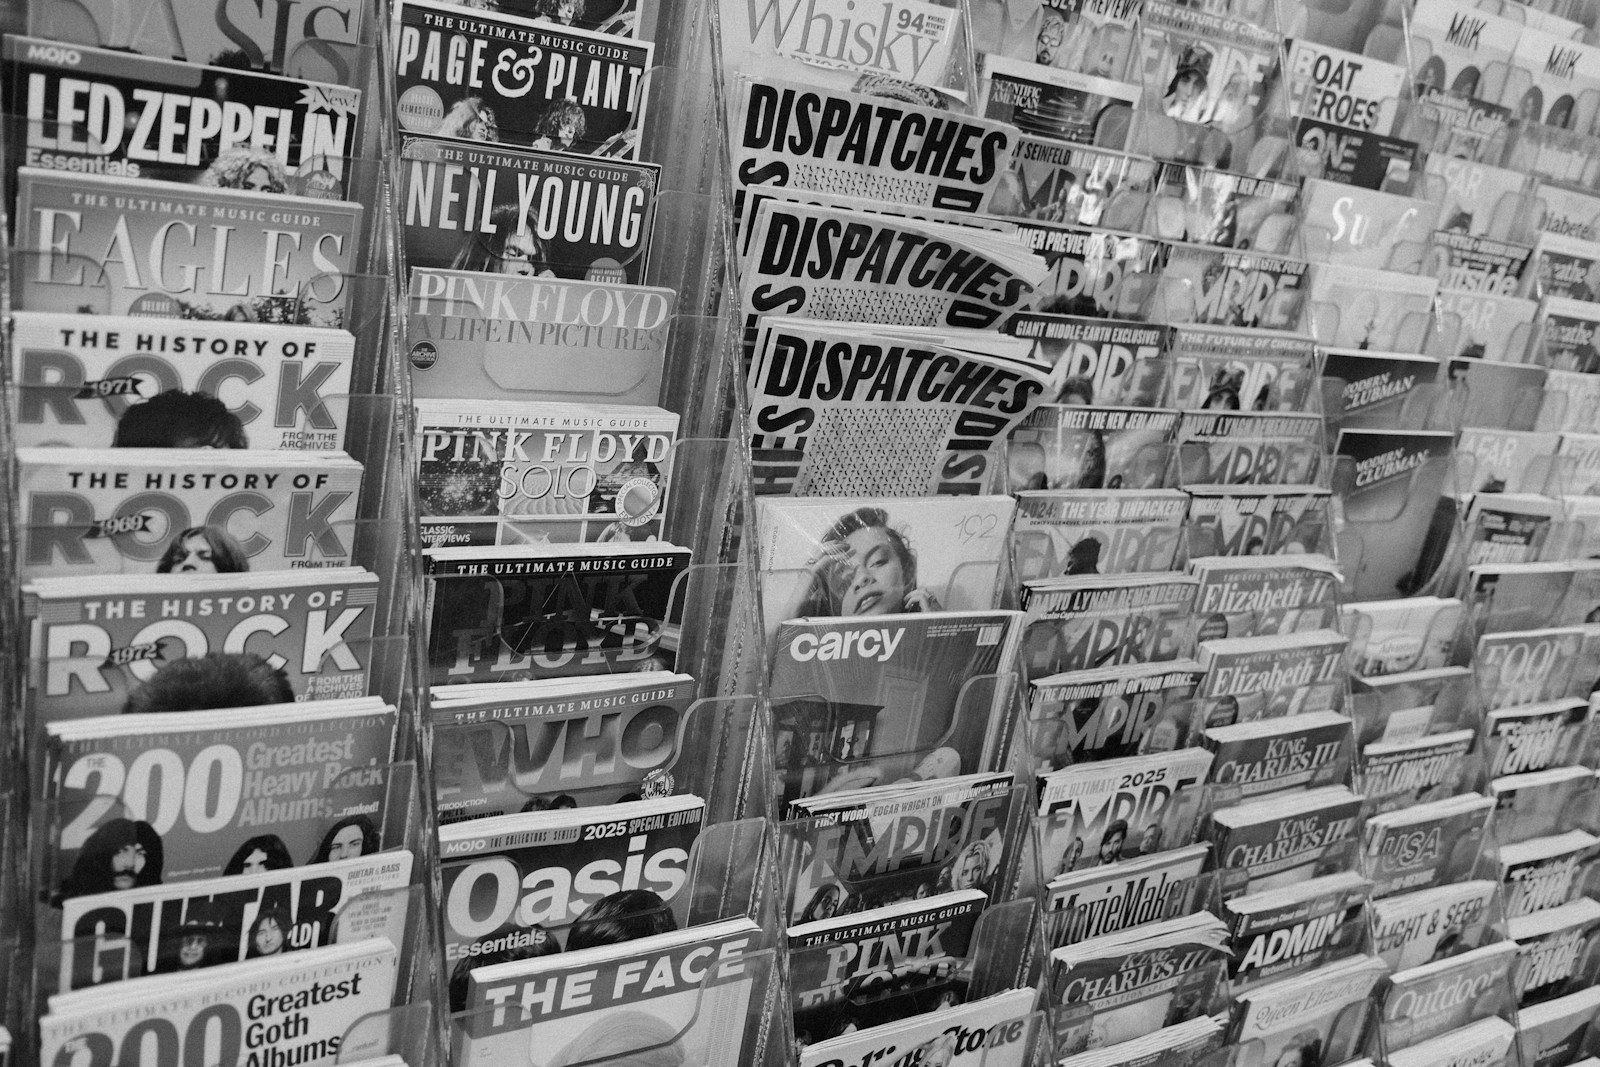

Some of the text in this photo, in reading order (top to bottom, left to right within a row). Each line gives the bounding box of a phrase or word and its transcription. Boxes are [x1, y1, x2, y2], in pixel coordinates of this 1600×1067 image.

[897, 9, 924, 31] 94
[424, 14, 629, 61] THE ULTIMATE MUSIC GUIDE
[748, 0, 940, 81] Whisky
[28, 45, 81, 65] MOJO
[399, 27, 642, 113] PAGE & PLANT
[27, 73, 348, 181] LED ZEPPELIN
[401, 104, 440, 118] REMASTERED
[743, 83, 1006, 185] DISPATCHES
[26, 148, 140, 178] Essentials
[435, 149, 629, 183] THE ULTIMATE MUSIC GUIDE
[1024, 143, 1071, 165] SEINFELD
[72, 192, 321, 227] THE ULTIMATE MUSIC GUIDE
[406, 160, 645, 248] NEIL YOUNG
[30, 208, 345, 304] EAGLES
[759, 212, 1035, 307] DISPATCHES
[415, 273, 668, 330] PINK FLOYD
[61, 329, 316, 358] THE HISTORY OF
[416, 316, 663, 351] A LIFE IN PICTURES
[1016, 320, 1160, 345] GIANT MIDDLE-EARTH EXCLUSIVE!
[17, 348, 342, 430] ROCK
[94, 377, 134, 397] 1971
[764, 334, 1044, 413] DISPATCHES
[282, 431, 338, 441] FROM THE
[458, 415, 649, 428] THE ULTIMATE MUSIC GUIDE
[280, 440, 336, 450] ARCHIVES
[422, 430, 671, 463] PINK FLOYD
[1356, 447, 1405, 472] MODERN
[69, 472, 329, 489] THE HISTORY OF
[499, 464, 598, 500] SOLO
[1356, 449, 1429, 487] CLUBMAN
[97, 515, 143, 536] 1969
[1061, 502, 1086, 518] THE
[25, 490, 353, 565] ROCK
[458, 556, 673, 575] THE ULTIMATE MUSIC GUIDE
[85, 589, 344, 620] THE HISTORY OF
[1031, 591, 1071, 612] DAVID
[1073, 589, 1116, 611] LYNCH
[1201, 580, 1303, 613] Elizabeth
[1306, 579, 1331, 604] II
[46, 607, 363, 697] ROCK
[112, 642, 159, 666] 1972
[790, 628, 905, 662] carcy
[306, 682, 363, 694] ARCHIVES
[309, 673, 364, 686] FROM THE
[1040, 687, 1059, 703] THE
[1060, 684, 1101, 701] RUNNING
[1126, 681, 1140, 694] ON
[1139, 676, 1163, 692] YOUR
[1210, 658, 1314, 697] Elizabeth
[1316, 654, 1340, 680] II
[455, 689, 675, 725] THE ULTIMATE MUSIC GUIDE
[247, 734, 355, 770] Greatest
[1215, 751, 1312, 783] CHARLES
[1310, 741, 1341, 769] III
[1264, 737, 1307, 760] KING
[61, 744, 243, 849] 200
[243, 766, 317, 800] Heavy
[1119, 768, 1167, 791] 2025
[583, 807, 701, 840] 2025 SPECIAL EDITION
[842, 796, 942, 823] WORD! EDGAR WRIGHT ON
[1275, 816, 1318, 840] KING
[446, 840, 486, 855] MOJO
[1226, 828, 1324, 868] CHARLES
[381, 863, 400, 874] BASS
[448, 834, 688, 938] Oasis
[806, 903, 972, 946] THE ULTIMATE MUSIC GUIDE
[446, 929, 546, 960] Essentials
[820, 921, 952, 988] PINK
[1120, 949, 1174, 972] KING
[486, 969, 598, 1027] THE
[612, 938, 749, 999] FACE
[1062, 949, 1213, 1006] CHARLES III
[247, 973, 362, 1021] Greatest
[245, 1013, 310, 1050] Goth
[246, 1034, 342, 1067] Albums
